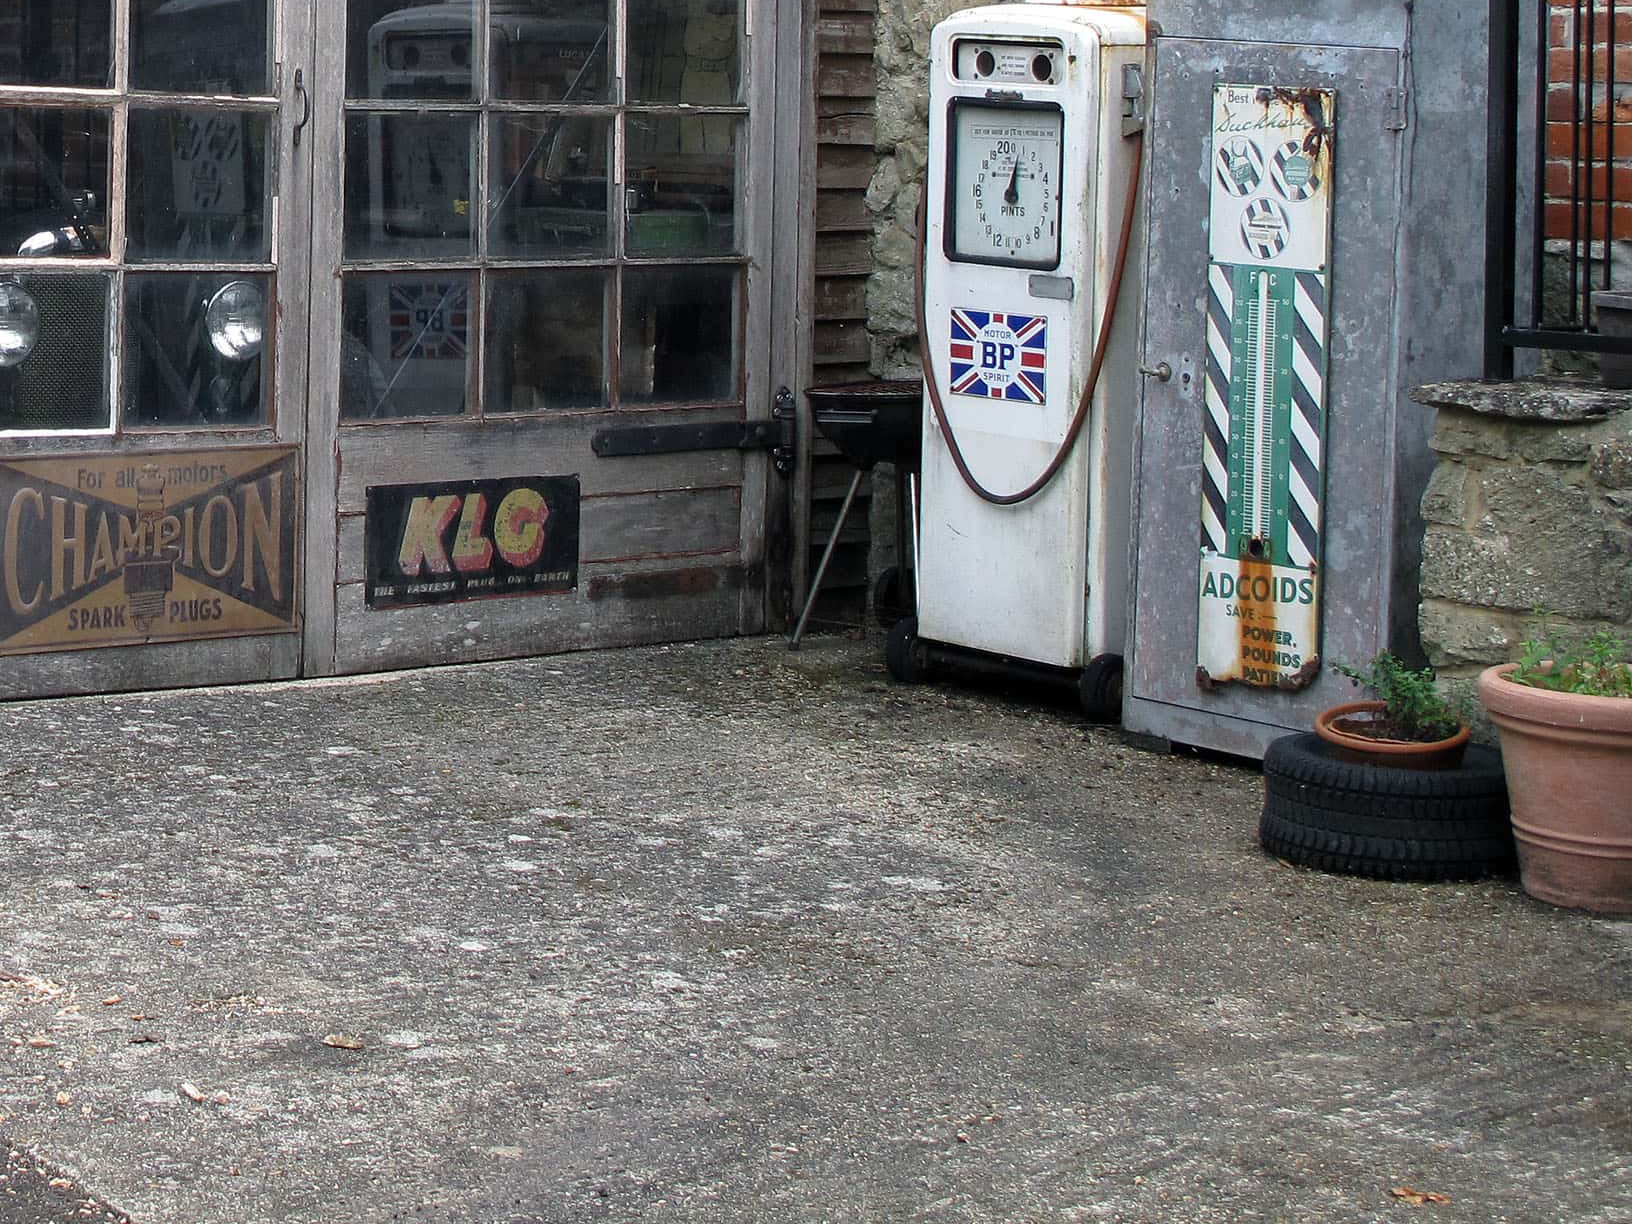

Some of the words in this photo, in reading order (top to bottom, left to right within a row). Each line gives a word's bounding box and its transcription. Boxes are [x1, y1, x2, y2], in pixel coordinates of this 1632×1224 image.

[1227, 91, 1249, 105] Best
[997, 141, 1009, 154] 20
[1011, 143, 1016, 153] 0
[989, 150, 997, 160] 19
[1031, 152, 1036, 161] 2
[1043, 172, 1048, 185] 4
[972, 184, 982, 197] 16
[1044, 189, 1049, 199] 5
[976, 199, 983, 209] 15
[1001, 206, 1025, 217] PINTS
[1034, 226, 1040, 239] 8
[993, 234, 1002, 247] 12
[1015, 238, 1022, 248] 10
[1250, 272, 1256, 284] F
[1270, 274, 1277, 286] C
[984, 329, 1012, 339] MOTOR
[980, 341, 1015, 370] BP
[983, 372, 1010, 382] SPIRIT
[77, 468, 105, 488] For
[115, 467, 135, 488] all
[168, 463, 228, 484] motors
[398, 488, 550, 576] KLG
[4, 471, 282, 615] CHAMPION
[373, 587, 395, 597] THE
[407, 580, 456, 595] FASTEST
[1202, 571, 1314, 605] ADCOIDS
[67, 603, 126, 632] SPARK
[169, 600, 223, 625] PLUGS
[1242, 645, 1301, 668] POUNDS
